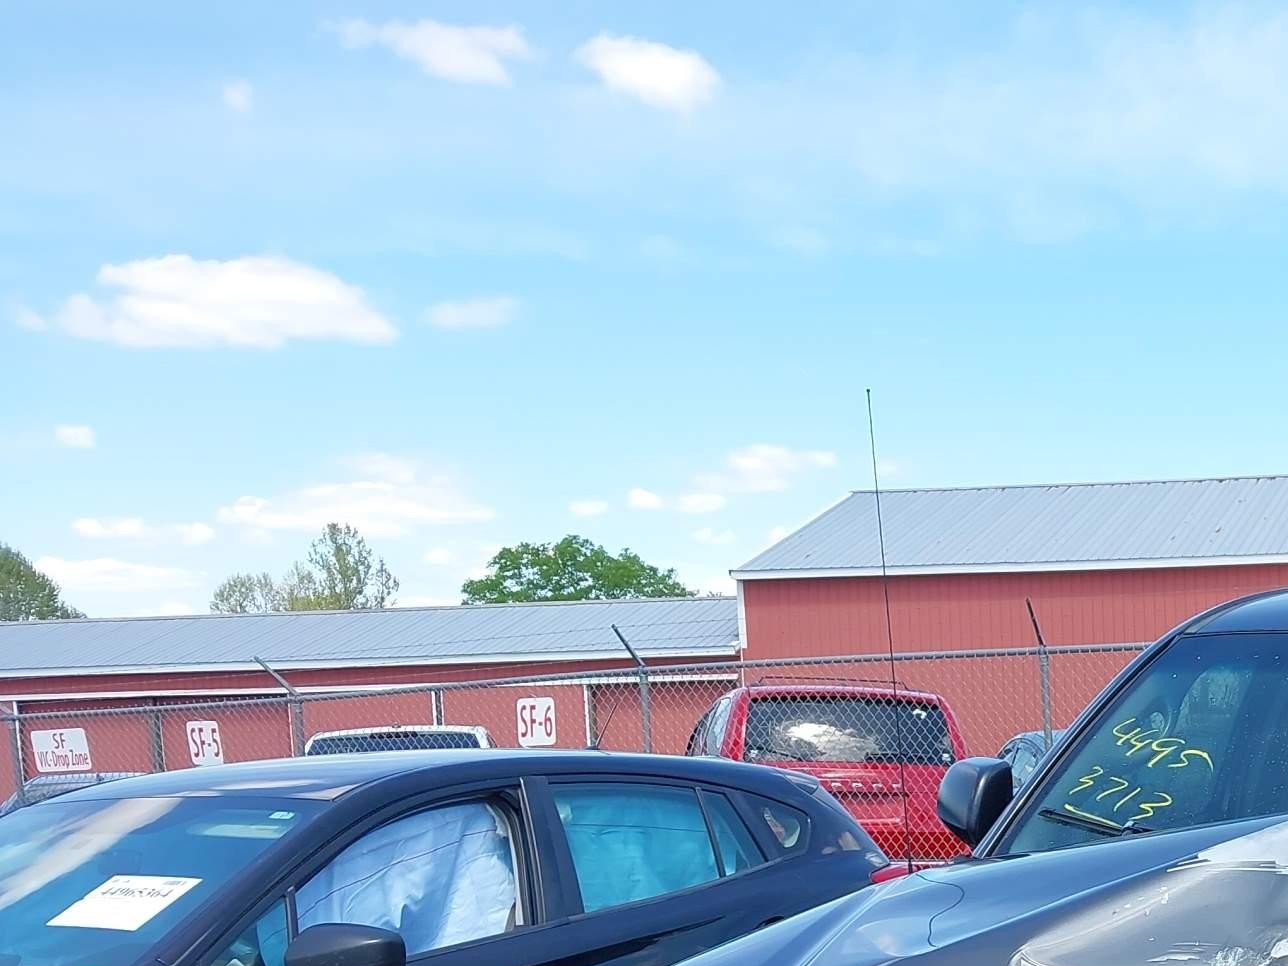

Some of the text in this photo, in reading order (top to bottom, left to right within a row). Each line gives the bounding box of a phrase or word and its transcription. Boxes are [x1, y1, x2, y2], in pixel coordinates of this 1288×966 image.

[520, 704, 553, 738] SF-6
[52, 732, 66, 749] SF
[189, 727, 220, 758] SF-5
[1113, 718, 1214, 773] 4495
[38, 749, 90, 768] VIC-Drop Zone
[1069, 766, 1173, 820] 3713
